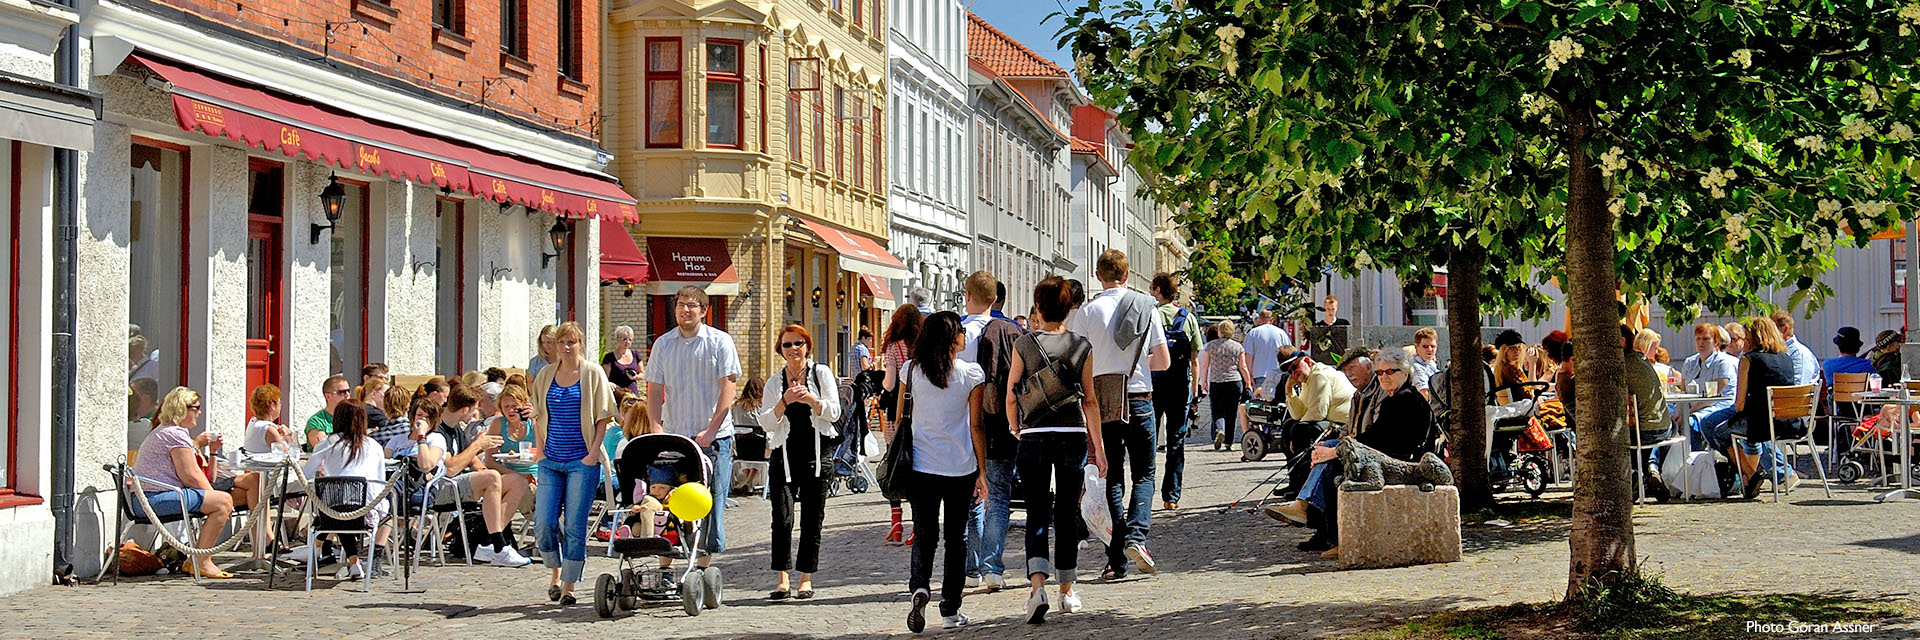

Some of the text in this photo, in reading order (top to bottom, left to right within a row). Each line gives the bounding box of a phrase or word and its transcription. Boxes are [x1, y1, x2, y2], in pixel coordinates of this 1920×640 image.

[194, 103, 222, 115] ESPRESSO
[671, 252, 712, 262] Hemma
[684, 261, 706, 271] Hos
